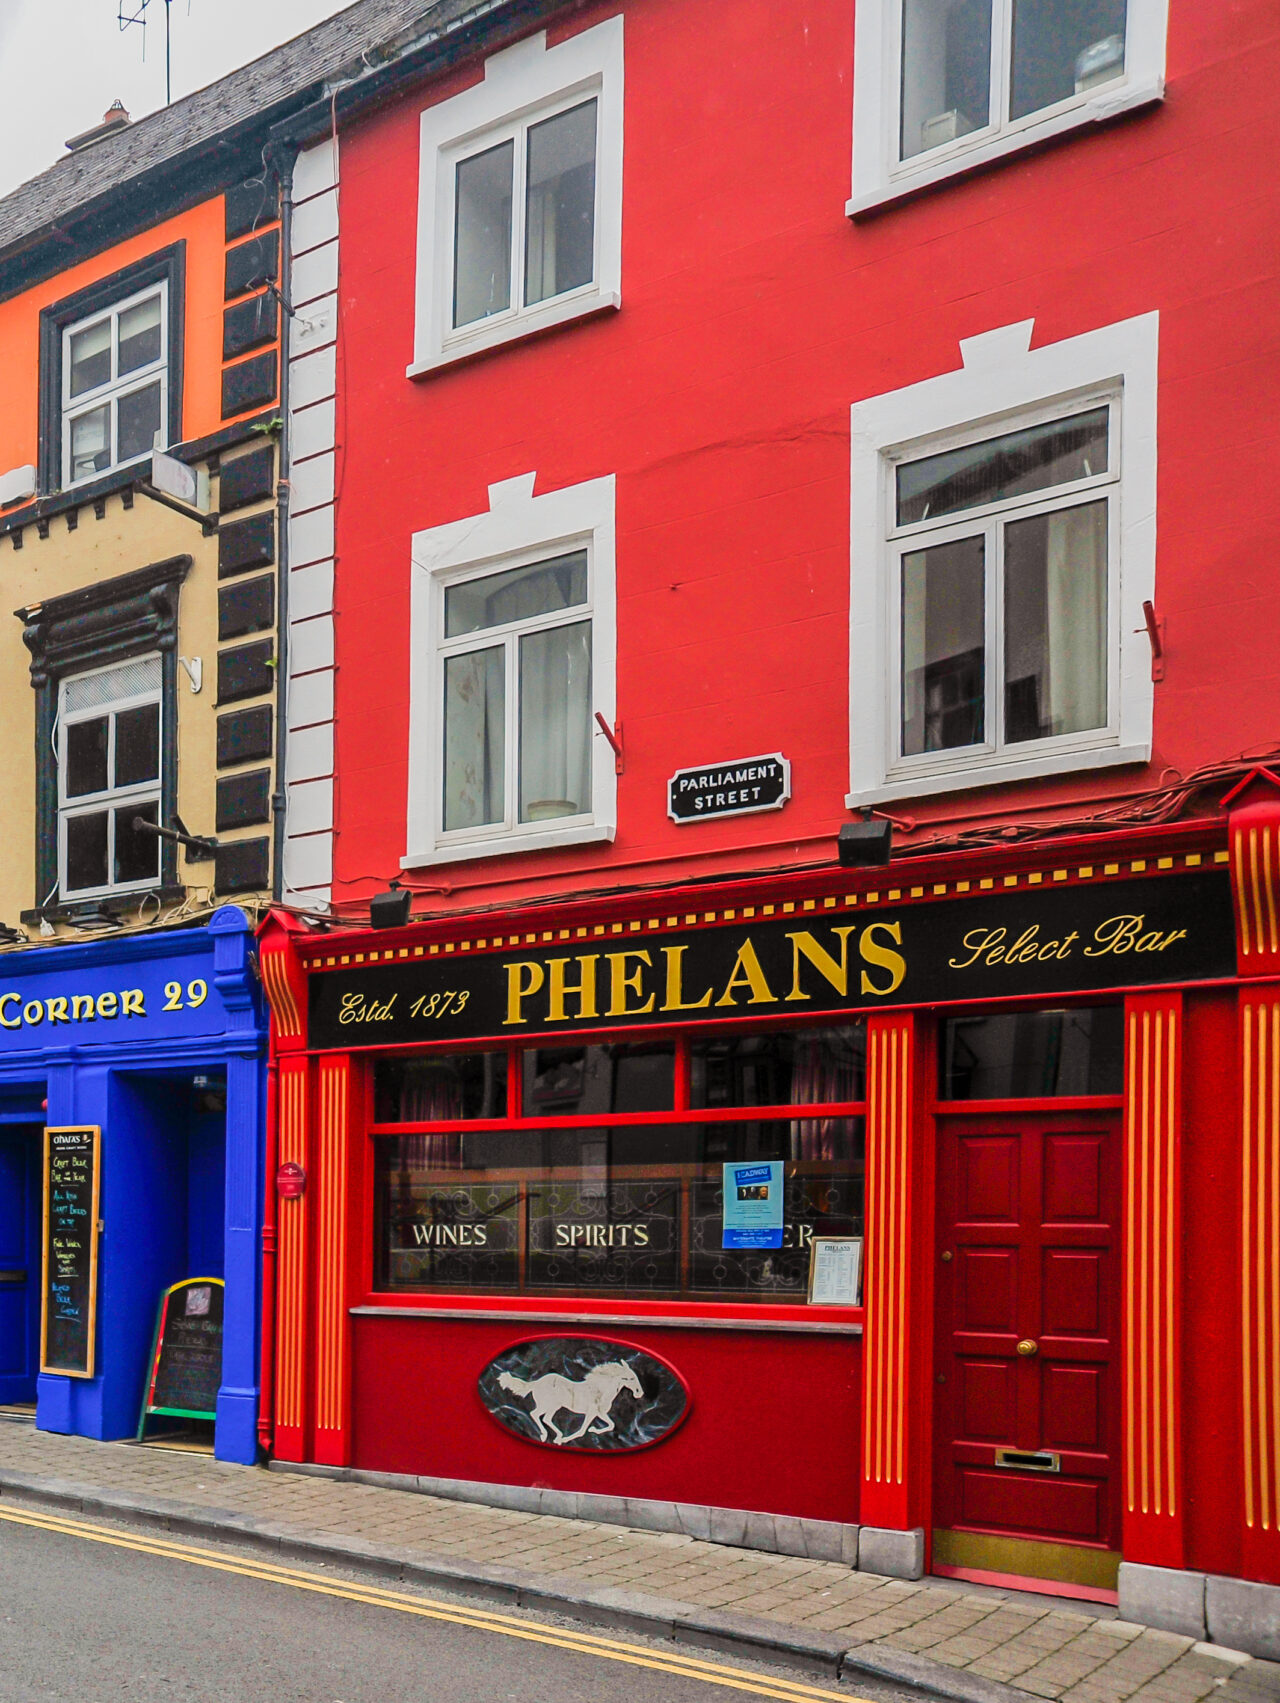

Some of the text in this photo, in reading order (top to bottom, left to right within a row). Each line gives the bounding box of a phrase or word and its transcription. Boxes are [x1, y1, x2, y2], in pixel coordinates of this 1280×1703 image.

[680, 764, 777, 792] PARLIAMENT
[694, 787, 761, 810] STREET
[948, 914, 1187, 969] Select Bar
[502, 921, 907, 1026] PHELANS
[161, 978, 209, 1013] 29
[338, 990, 471, 1025] Estd. 1873
[413, 1224, 487, 1246] WINES
[555, 1224, 649, 1246] SPIRITS
